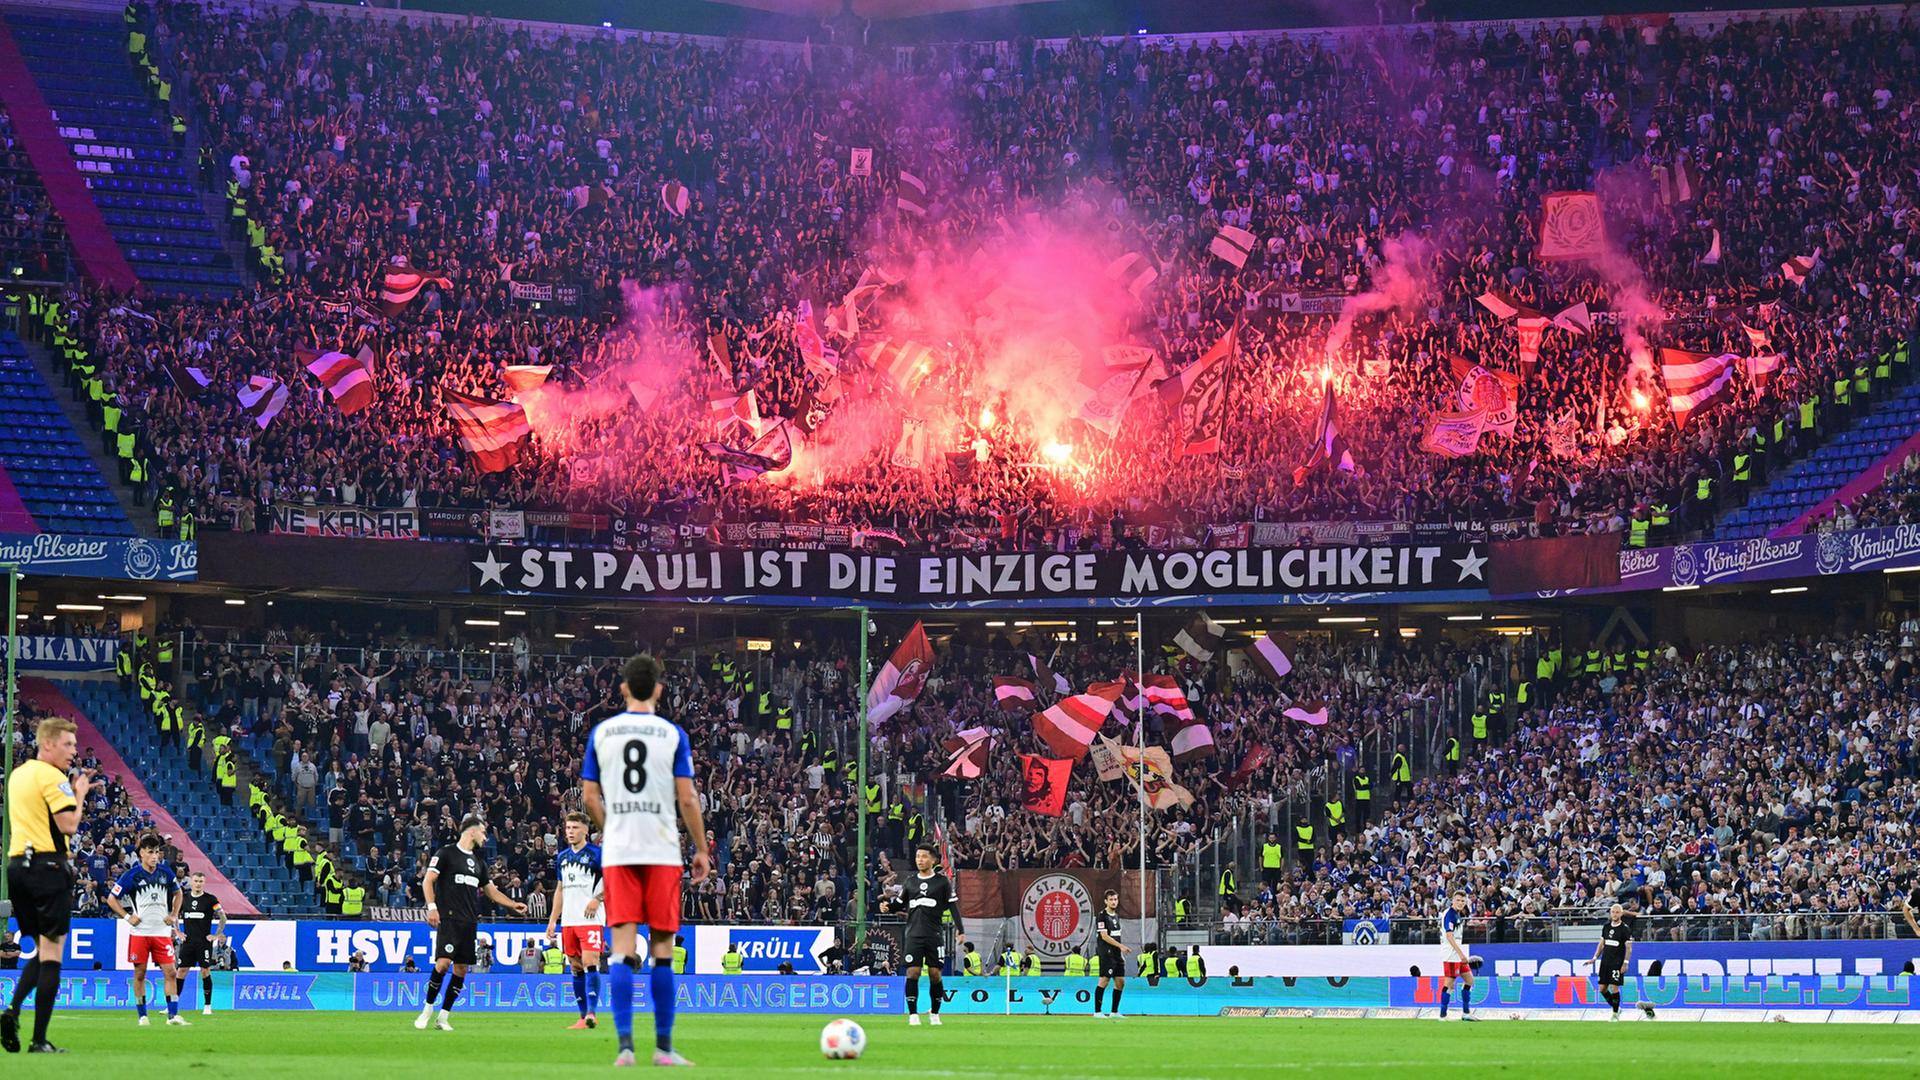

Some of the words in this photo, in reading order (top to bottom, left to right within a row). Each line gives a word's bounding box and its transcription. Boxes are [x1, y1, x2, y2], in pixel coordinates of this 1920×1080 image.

[1487, 411, 1508, 423] 910
[319, 509, 415, 539] KADAR
[743, 550, 808, 588] IST
[829, 552, 897, 593] DIE
[919, 553, 1097, 595] EINZIGE
[1120, 547, 1441, 594] MÖGLICHKEIT
[623, 739, 647, 793] 8
[1025, 896, 1038, 912] FC
[1059, 879, 1090, 913] PAULI
[370, 906, 428, 921] HENNIN
[588, 930, 600, 944] 21
[735, 937, 804, 959] KRÜLL
[1043, 940, 1071, 953] 1910
[1612, 969, 1620, 979] 23
[239, 982, 301, 1000] KRÜLL
[942, 989, 1091, 1002] VOLVO
[1230, 1008, 1264, 1017] buXtrade
